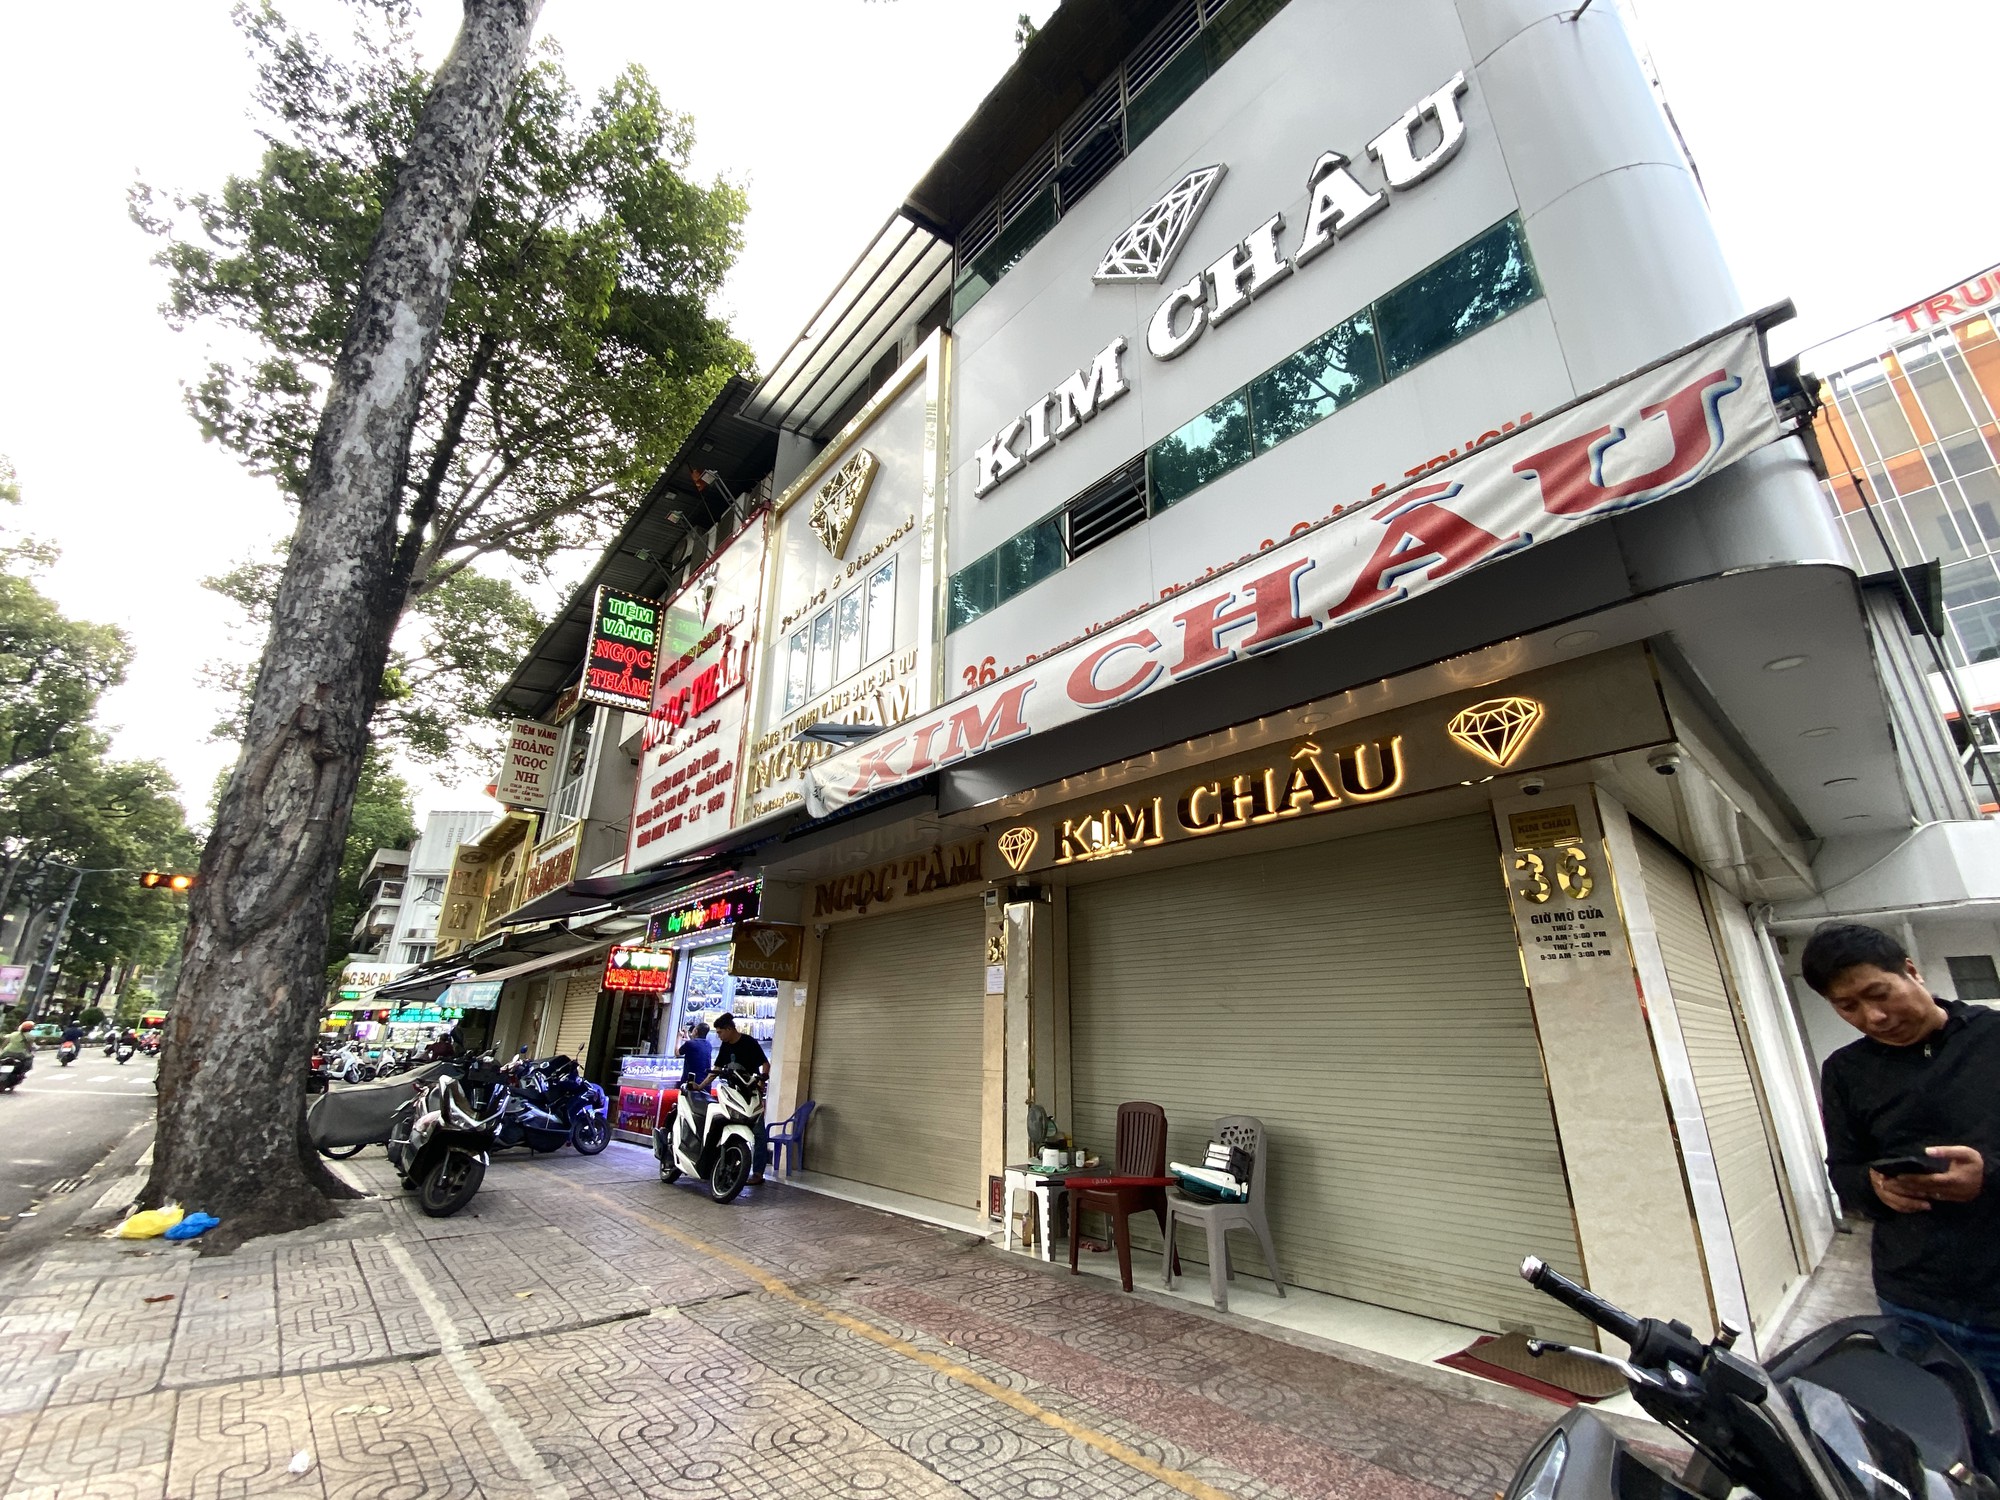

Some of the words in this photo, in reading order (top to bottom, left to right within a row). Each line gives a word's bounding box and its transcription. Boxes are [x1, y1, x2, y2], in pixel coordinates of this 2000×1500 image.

[974, 335, 1131, 499] KIM
[1147, 71, 1468, 361] CHÂU
[846, 514, 914, 578] Diamond
[847, 678, 1039, 798] KIM
[1066, 368, 1742, 711] CHÂU
[609, 597, 654, 624] TIỆM
[602, 617, 654, 644] VÀNG
[594, 640, 652, 668] NGỌC
[962, 656, 996, 693] 36
[759, 730, 780, 755] CÔNG
[782, 722, 793, 742] TY
[822, 691, 849, 719] VÀNG
[852, 676, 876, 701] BẠC
[878, 659, 894, 687] ĐÁ
[899, 648, 918, 674] QU
[517, 724, 535, 736] TIỆM
[538, 728, 558, 740] VÀNG
[642, 687, 690, 752] NGỌC
[511, 738, 554, 756] HOÀNG
[512, 754, 548, 770] NGỌC
[515, 770, 540, 784] NHI
[1054, 796, 1164, 864] KIM
[1177, 735, 1403, 834] CHÂU
[812, 864, 897, 916] NGỌC
[902, 840, 984, 896] TÂM
[1515, 847, 1593, 904] 36
[1530, 912, 1552, 924] GIỜ
[1554, 908, 1574, 922] MỞ
[1578, 905, 1604, 919] CỬA
[358, 972, 378, 988] BẠC
[738, 960, 768, 972] NGỌC
